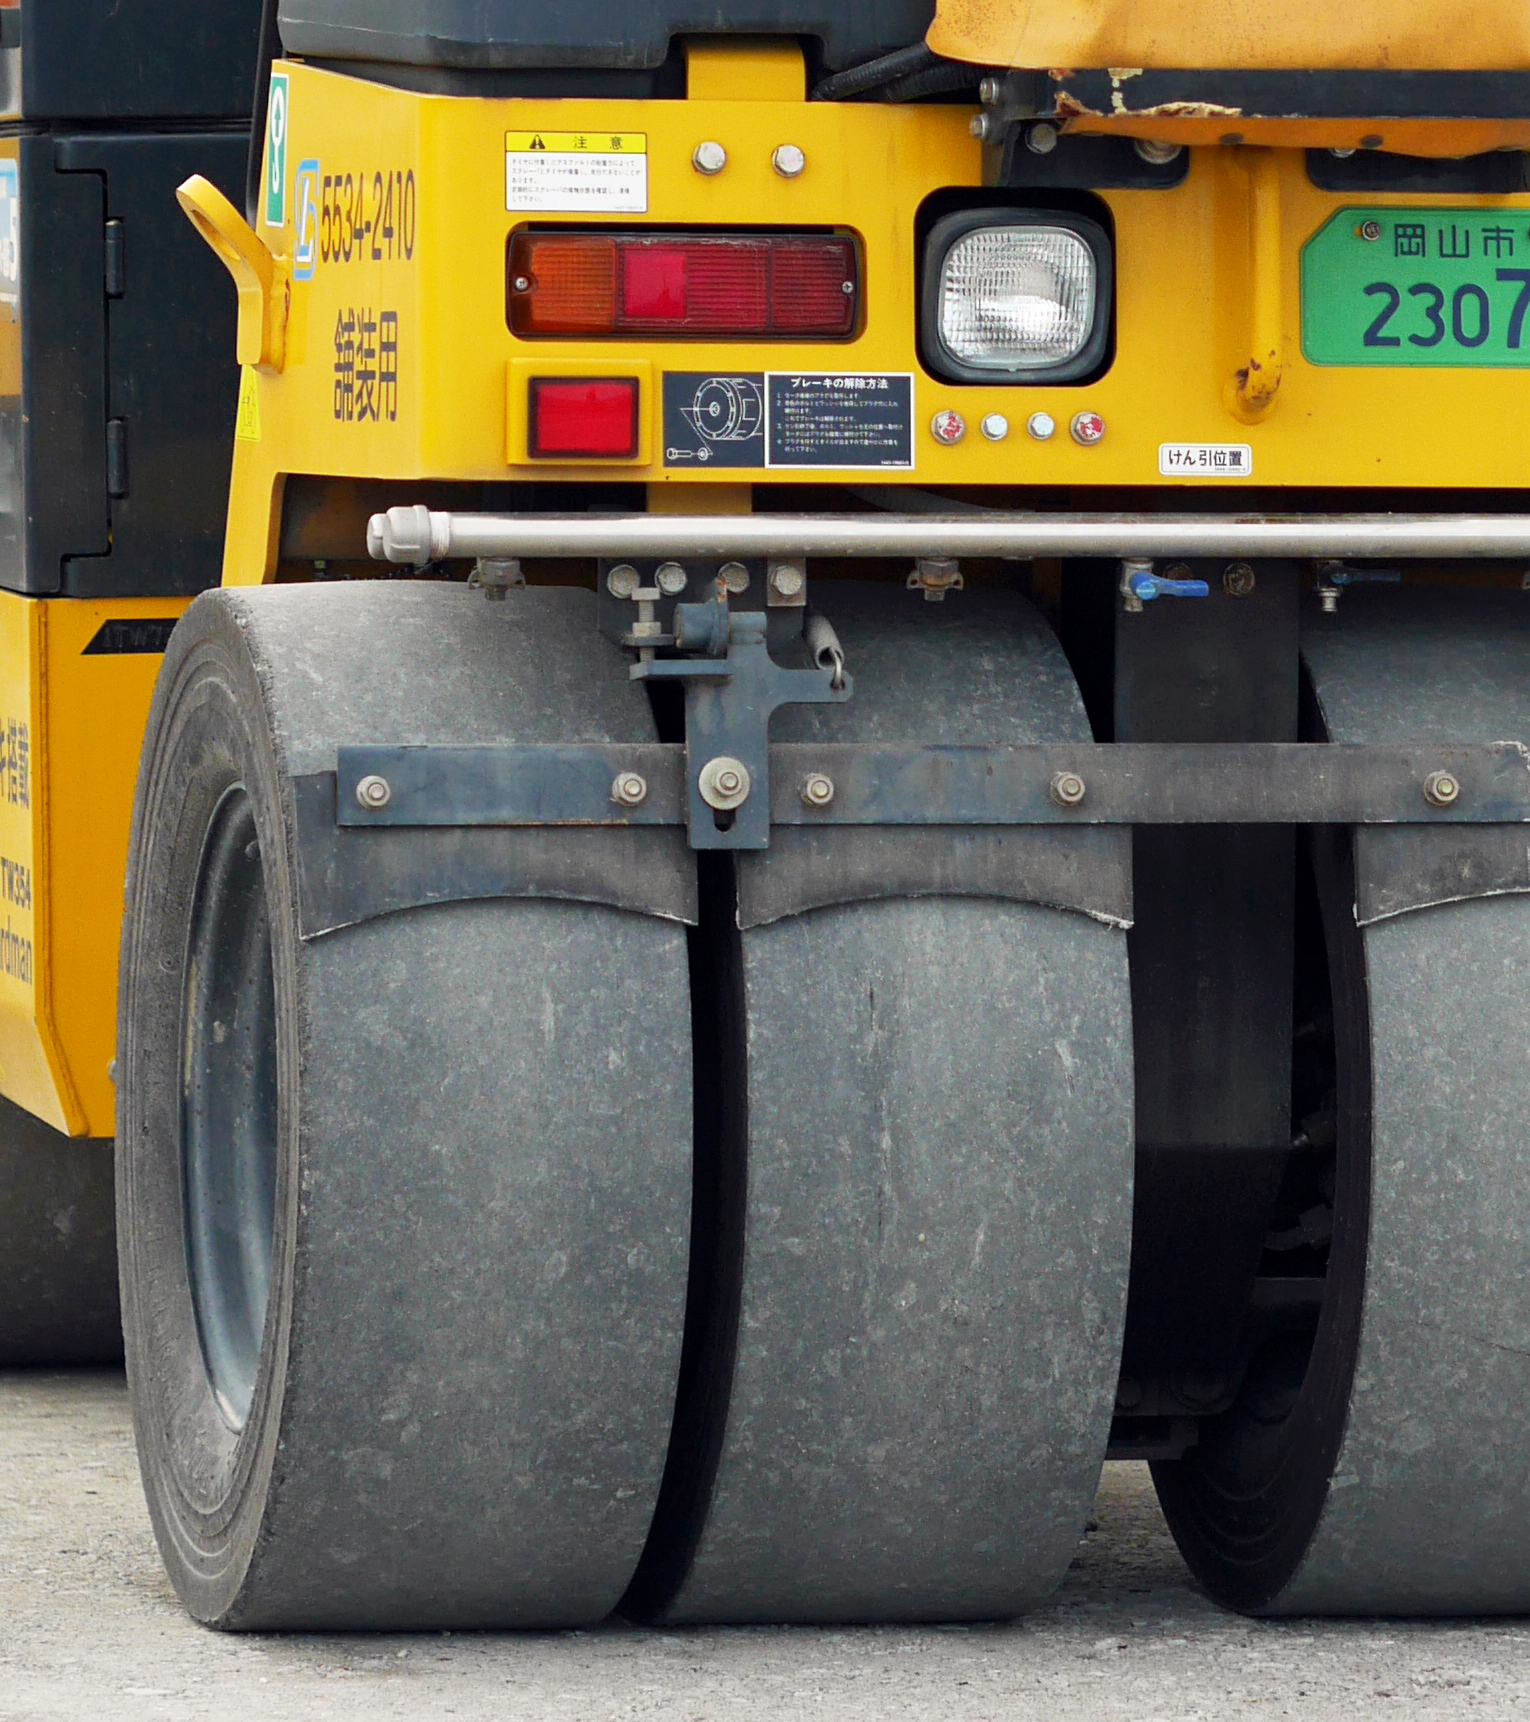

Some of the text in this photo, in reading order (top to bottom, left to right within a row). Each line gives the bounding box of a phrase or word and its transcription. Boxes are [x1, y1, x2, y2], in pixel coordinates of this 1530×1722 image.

[573, 136, 623, 150] 注意
[321, 169, 416, 264] 5534-2410
[1394, 223, 1515, 258] 岡山市
[334, 307, 398, 422] 舗装用
[790, 377, 889, 389] ブレーキの解除方法
[1168, 449, 1242, 466] けん引位置
